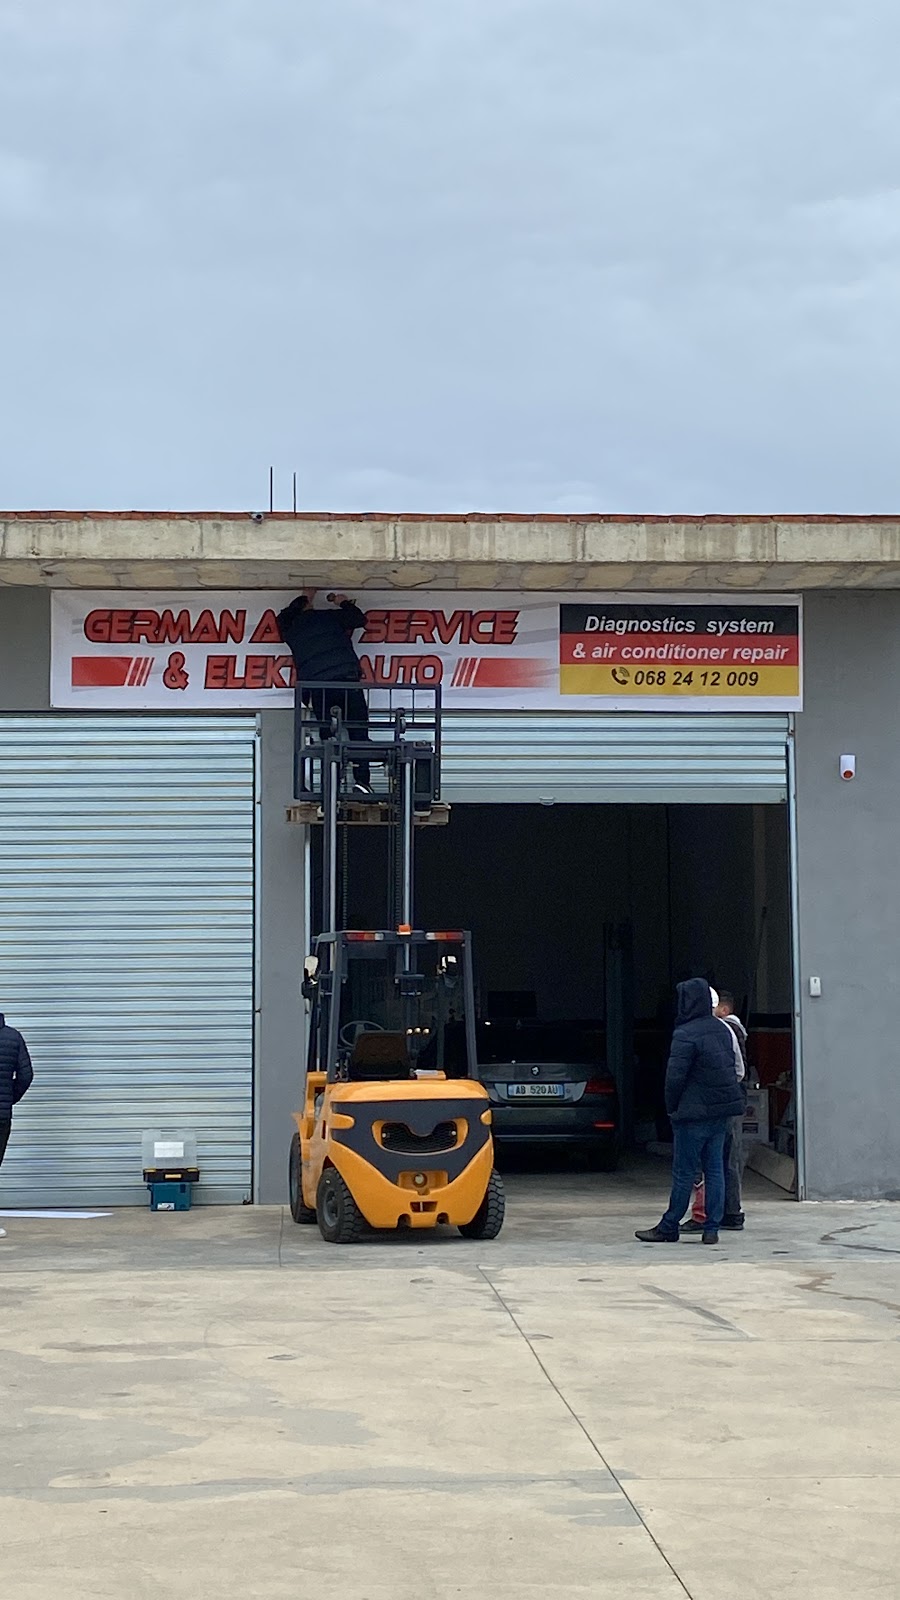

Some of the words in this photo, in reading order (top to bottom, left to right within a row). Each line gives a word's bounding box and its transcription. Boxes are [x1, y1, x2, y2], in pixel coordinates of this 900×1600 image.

[84, 609, 247, 643] GERMAN
[358, 609, 519, 644] SERVICE
[585, 616, 696, 635] Diagnostics
[706, 619, 774, 636] system
[572, 642, 586, 658] &
[591, 643, 617, 658] air
[621, 644, 729, 659] conditioner
[732, 645, 788, 663] repair
[163, 651, 189, 690] &
[634, 671, 666, 685] 068
[672, 671, 693, 686] 24
[700, 671, 721, 686] 12
[726, 672, 759, 686] 009
[530, 1085, 547, 1095] 520
